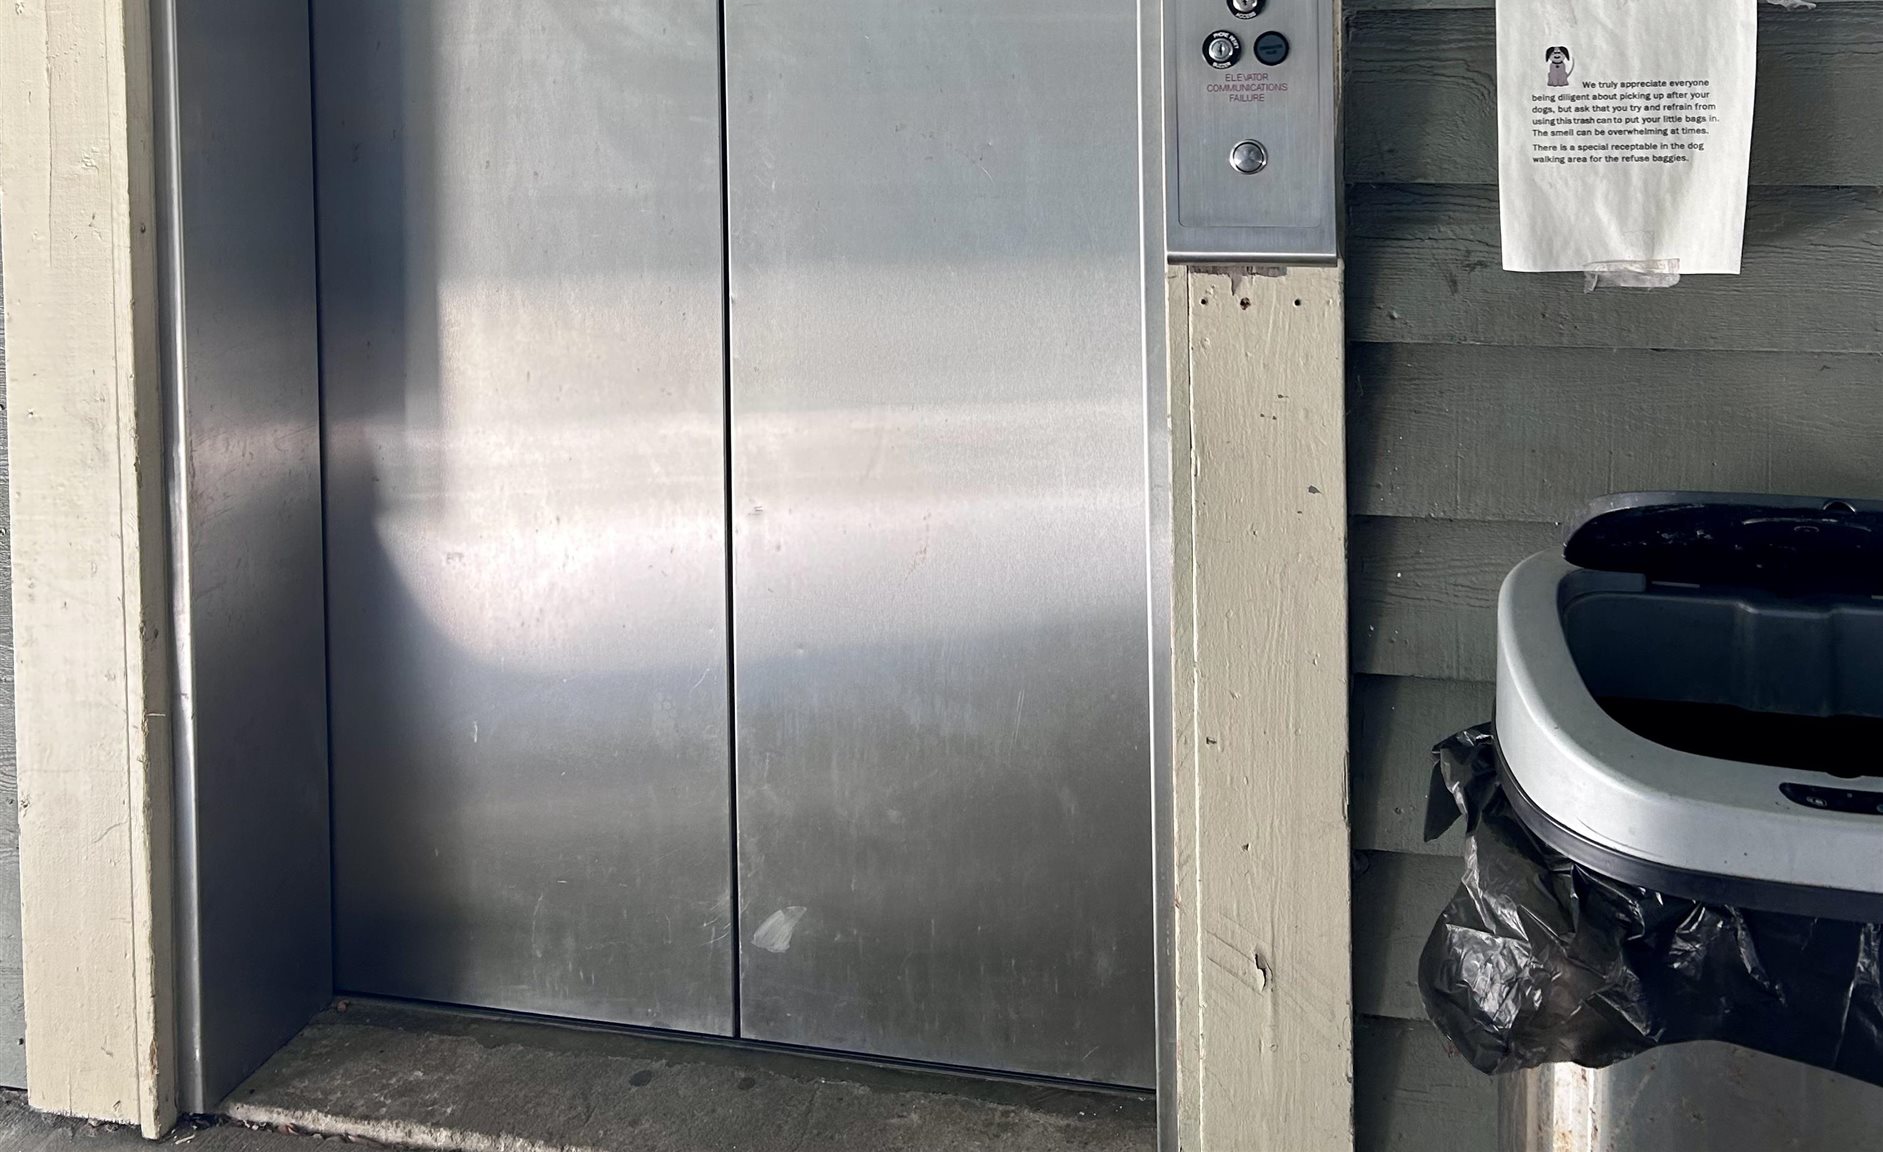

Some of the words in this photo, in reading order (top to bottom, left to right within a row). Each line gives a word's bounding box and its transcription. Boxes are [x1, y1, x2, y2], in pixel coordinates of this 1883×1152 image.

[1235, 11, 1257, 20] ACCESS
[1225, 73, 1268, 82] ELEVATOR
[1206, 83, 1288, 92] COMMUNICATIONS
[1582, 81, 1596, 89] We
[1598, 81, 1618, 90] truly
[1620, 79, 1667, 89] appreciate
[1669, 80, 1710, 88] everyone
[1229, 93, 1265, 102] FAILURE
[1531, 94, 1556, 102] being
[1557, 93, 1590, 102] diligent
[1619, 92, 1651, 101] picking
[1666, 91, 1688, 99] after
[1690, 91, 1710, 100] your
[1531, 106, 1556, 114] dogs,
[1574, 105, 1590, 113] ask
[1629, 104, 1642, 113] try
[1662, 103, 1693, 111] refrain
[1532, 118, 1556, 126] using
[1556, 117, 1572, 125] this
[1641, 116, 1661, 124] your
[1663, 115, 1683, 123] little
[1685, 115, 1707, 123] bags
[1708, 114, 1720, 122] in.
[1550, 128, 1574, 136] smell
[1594, 128, 1606, 136] be
[1607, 127, 1668, 136] overwhelming
[1577, 143, 1608, 152] special
[1610, 142, 1658, 151] receptable
[1660, 142, 1668, 150] in
[1670, 142, 1685, 150] the
[1687, 142, 1704, 151] dog
[1532, 156, 1565, 164] walking
[1589, 155, 1603, 163] for
[1652, 154, 1689, 163] baggies.
